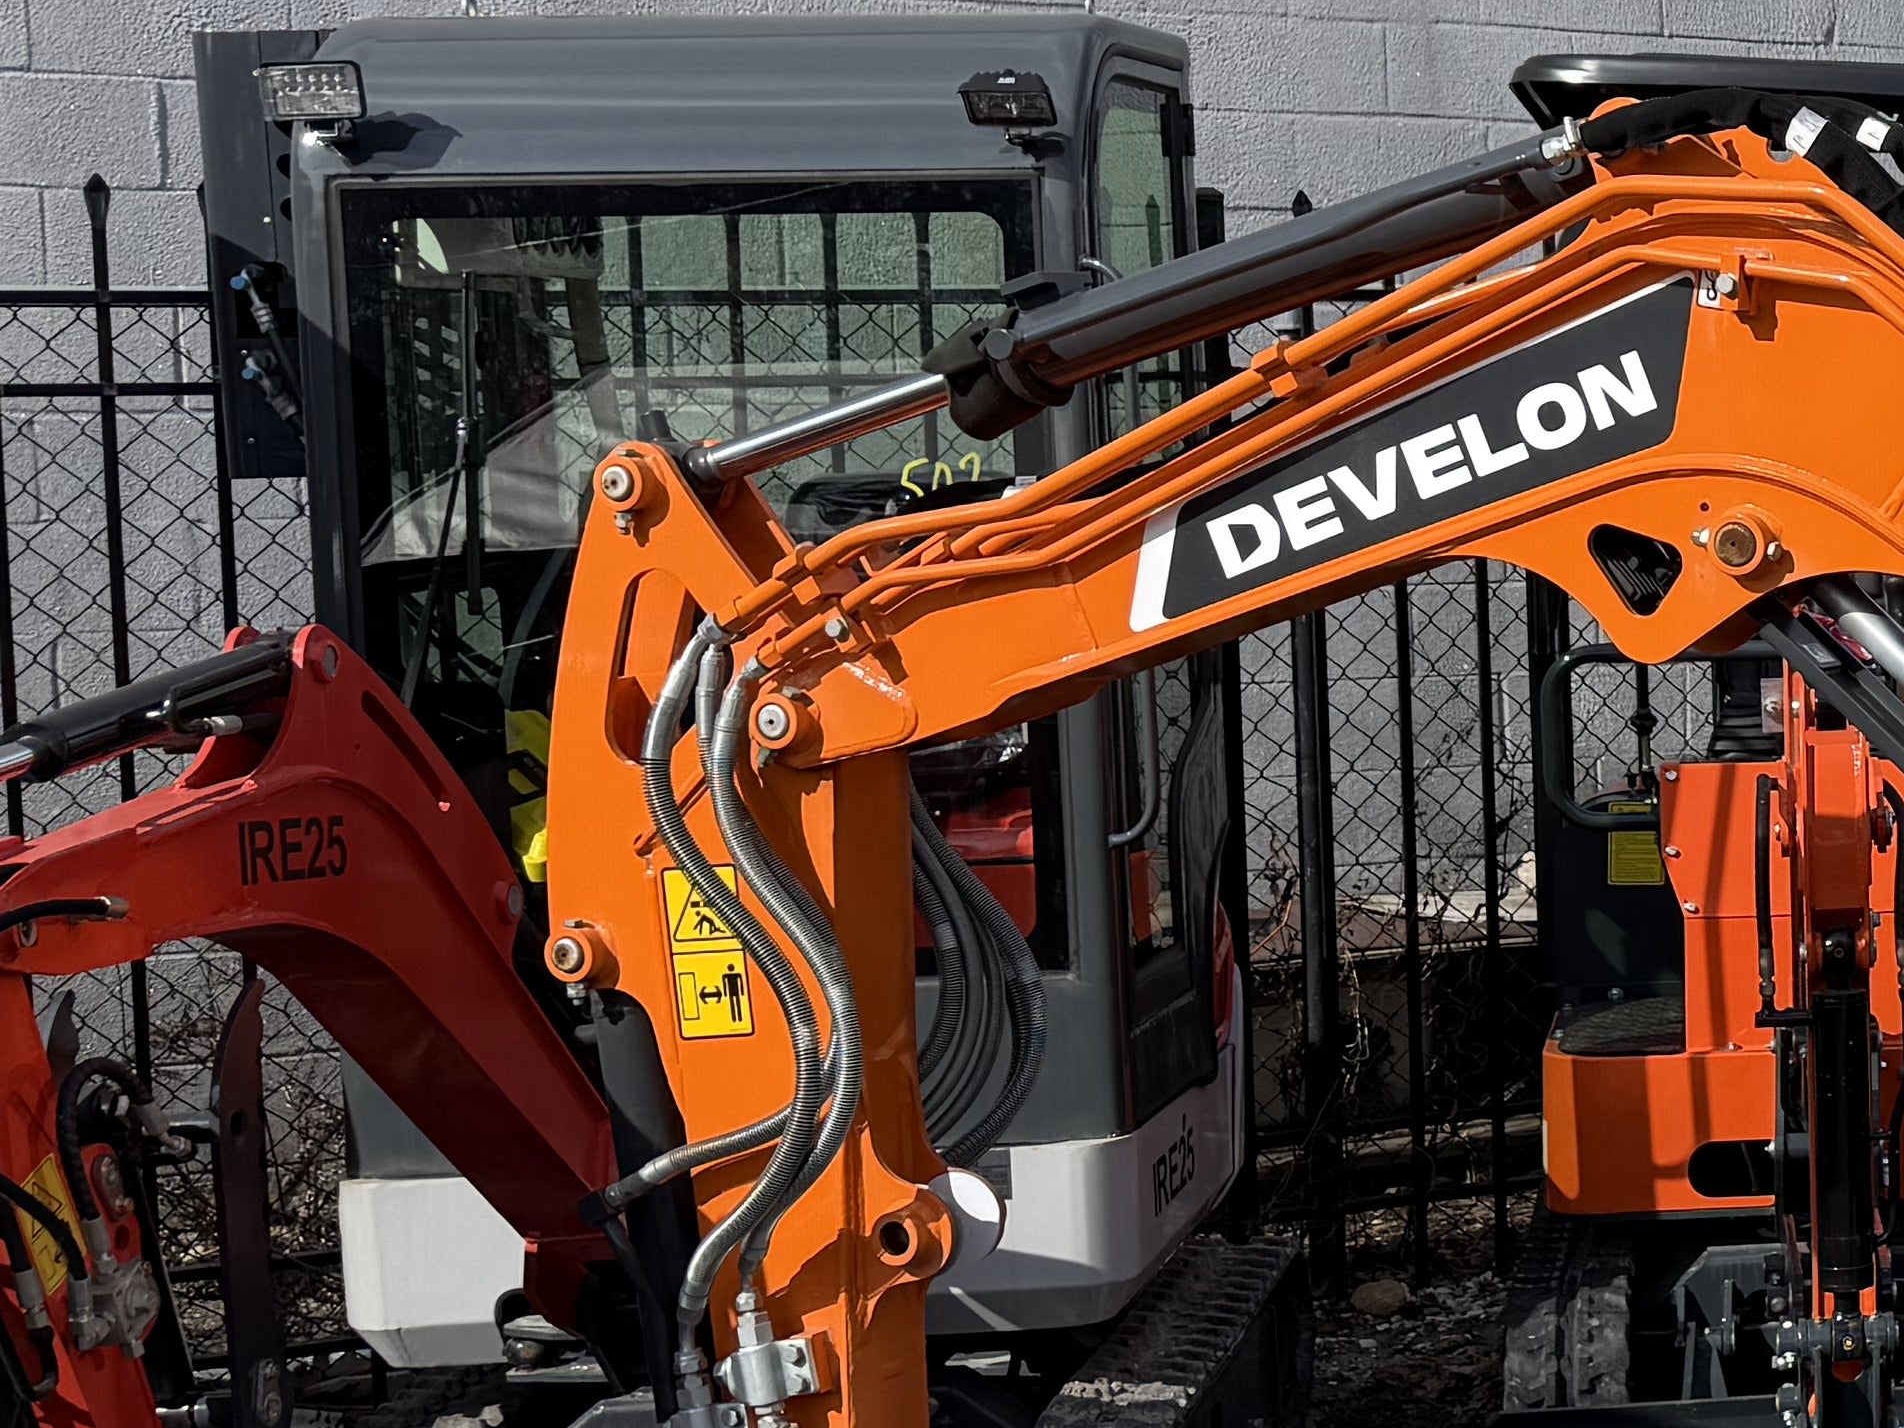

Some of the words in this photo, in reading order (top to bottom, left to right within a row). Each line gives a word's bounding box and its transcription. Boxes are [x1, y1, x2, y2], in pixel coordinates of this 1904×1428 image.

[1205, 349, 1659, 580] DEVELON
[237, 814, 349, 887] IRE25
[1152, 1126, 1196, 1218] IRE25
